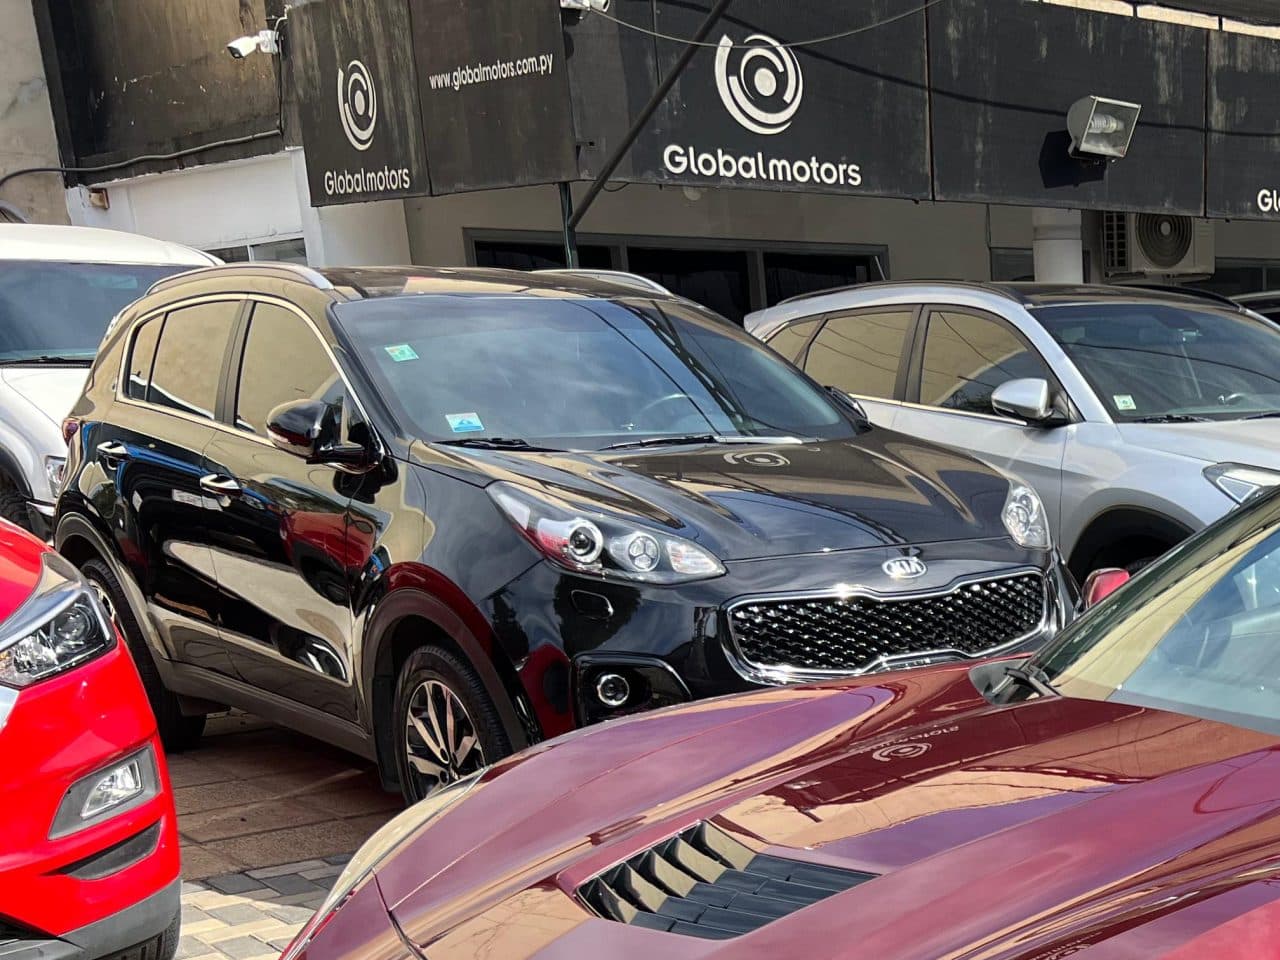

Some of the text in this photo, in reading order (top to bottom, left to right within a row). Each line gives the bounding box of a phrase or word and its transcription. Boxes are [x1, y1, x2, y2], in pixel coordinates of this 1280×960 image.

[429, 53, 553, 91] www.globalmotors.com.py
[324, 165, 410, 195] Globalmotors
[663, 144, 862, 186] Globalmotors
